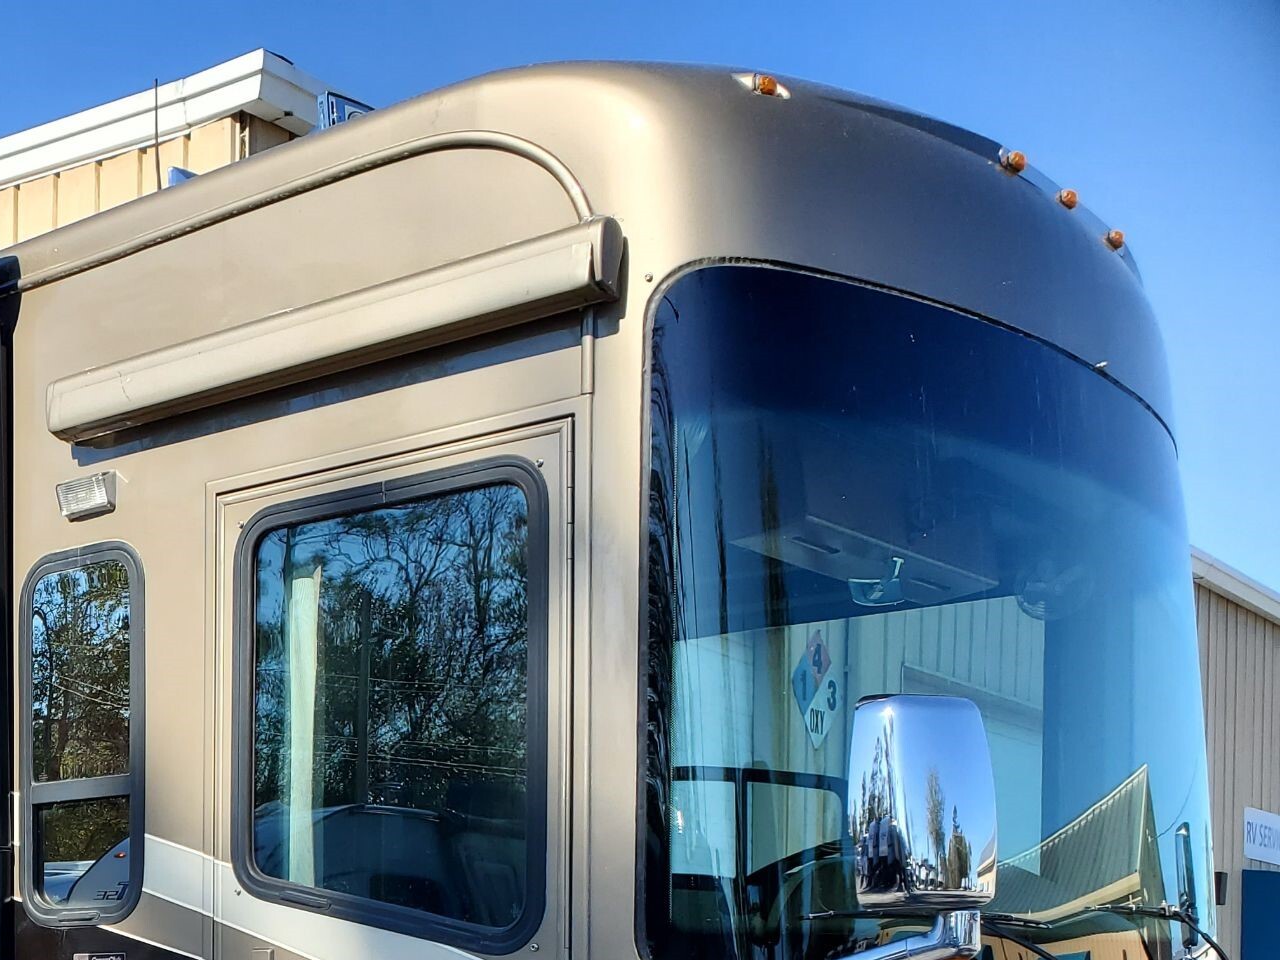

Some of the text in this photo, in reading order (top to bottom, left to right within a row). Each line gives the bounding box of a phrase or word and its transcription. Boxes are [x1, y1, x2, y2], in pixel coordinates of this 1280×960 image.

[812, 643, 823, 675] 4
[800, 669, 807, 701] 1
[826, 679, 838, 712] 3
[809, 707, 826, 735] OXY
[1246, 821, 1280, 852] RV SERVI
